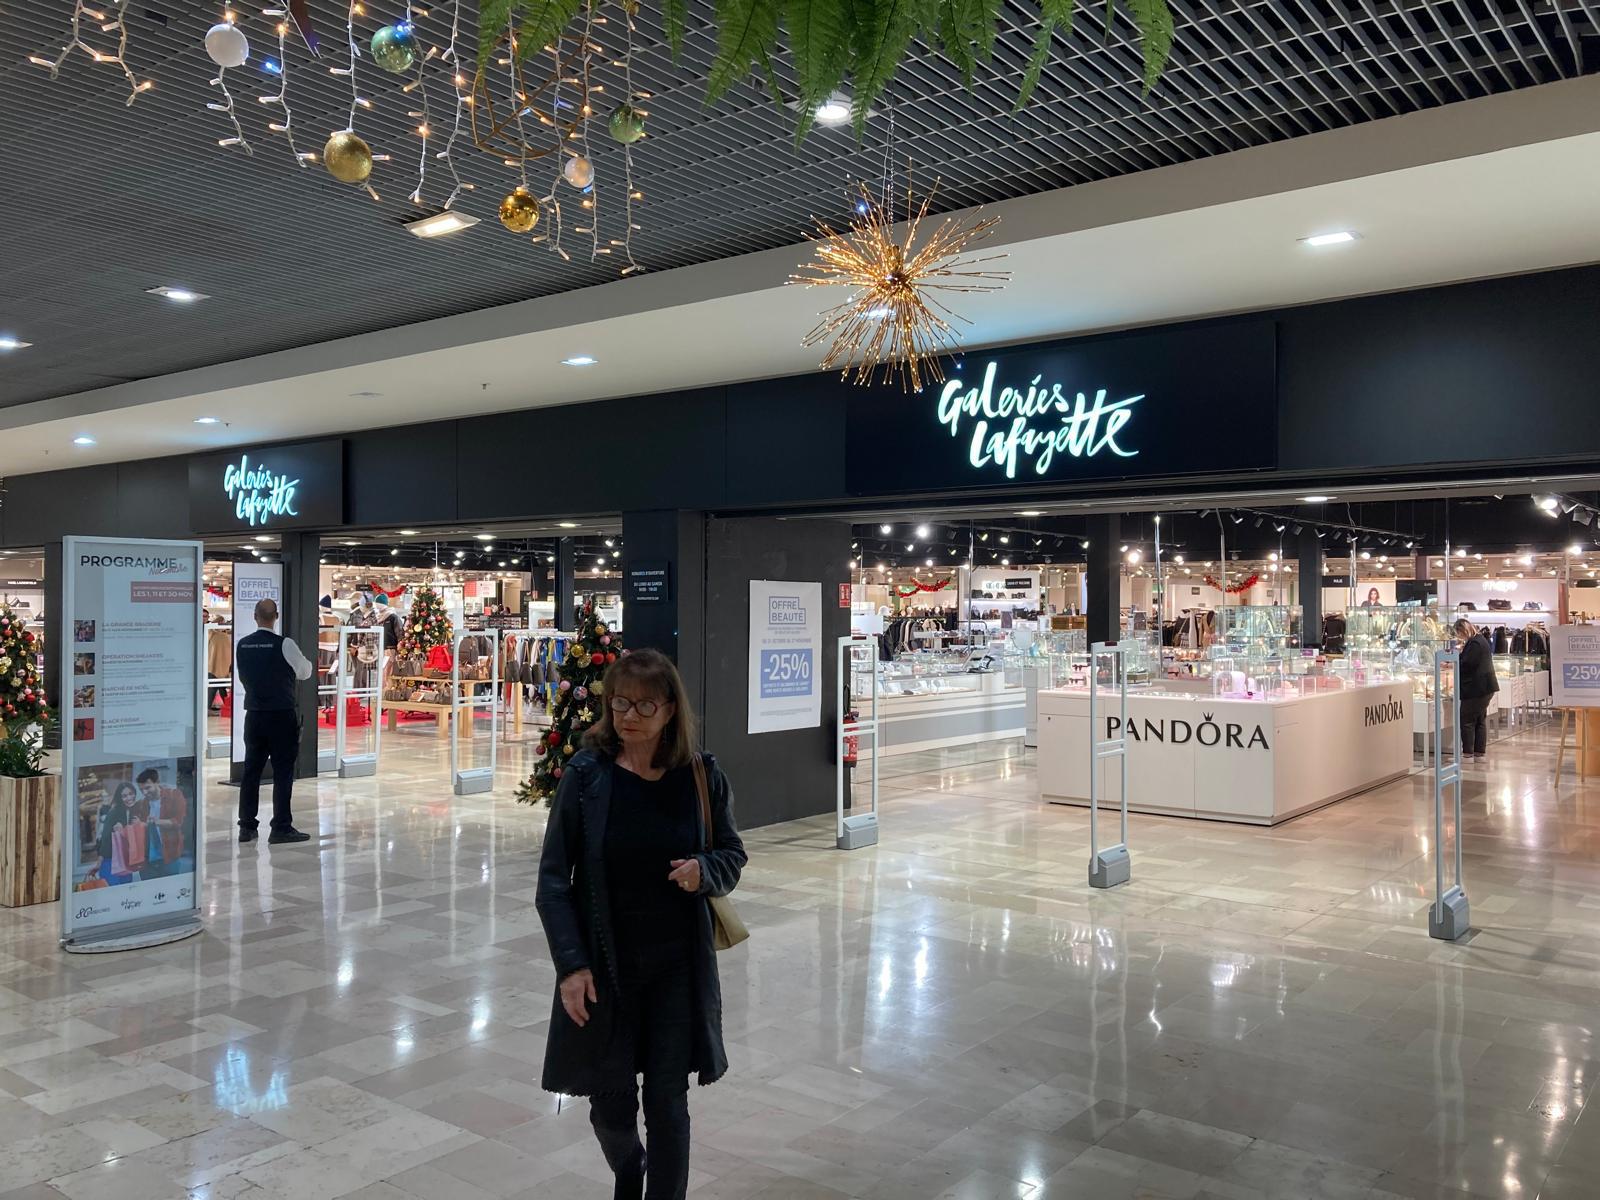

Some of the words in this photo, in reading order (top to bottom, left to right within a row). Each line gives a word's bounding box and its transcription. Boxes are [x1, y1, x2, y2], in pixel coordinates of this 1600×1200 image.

[938, 361, 1069, 437] Galeries
[969, 389, 1146, 479] Lafayette
[224, 454, 274, 500] Galeries
[236, 474, 300, 526] Lafayette
[80, 555, 177, 569] PROGRAMME
[241, 580, 269, 589] OFFRE
[771, 600, 797, 610] OFFRE
[771, 610, 804, 622] BEAUTÉ
[764, 653, 810, 681] -25%
[1364, 698, 1404, 727] PANDORA
[1106, 714, 1270, 750] PANDORA
